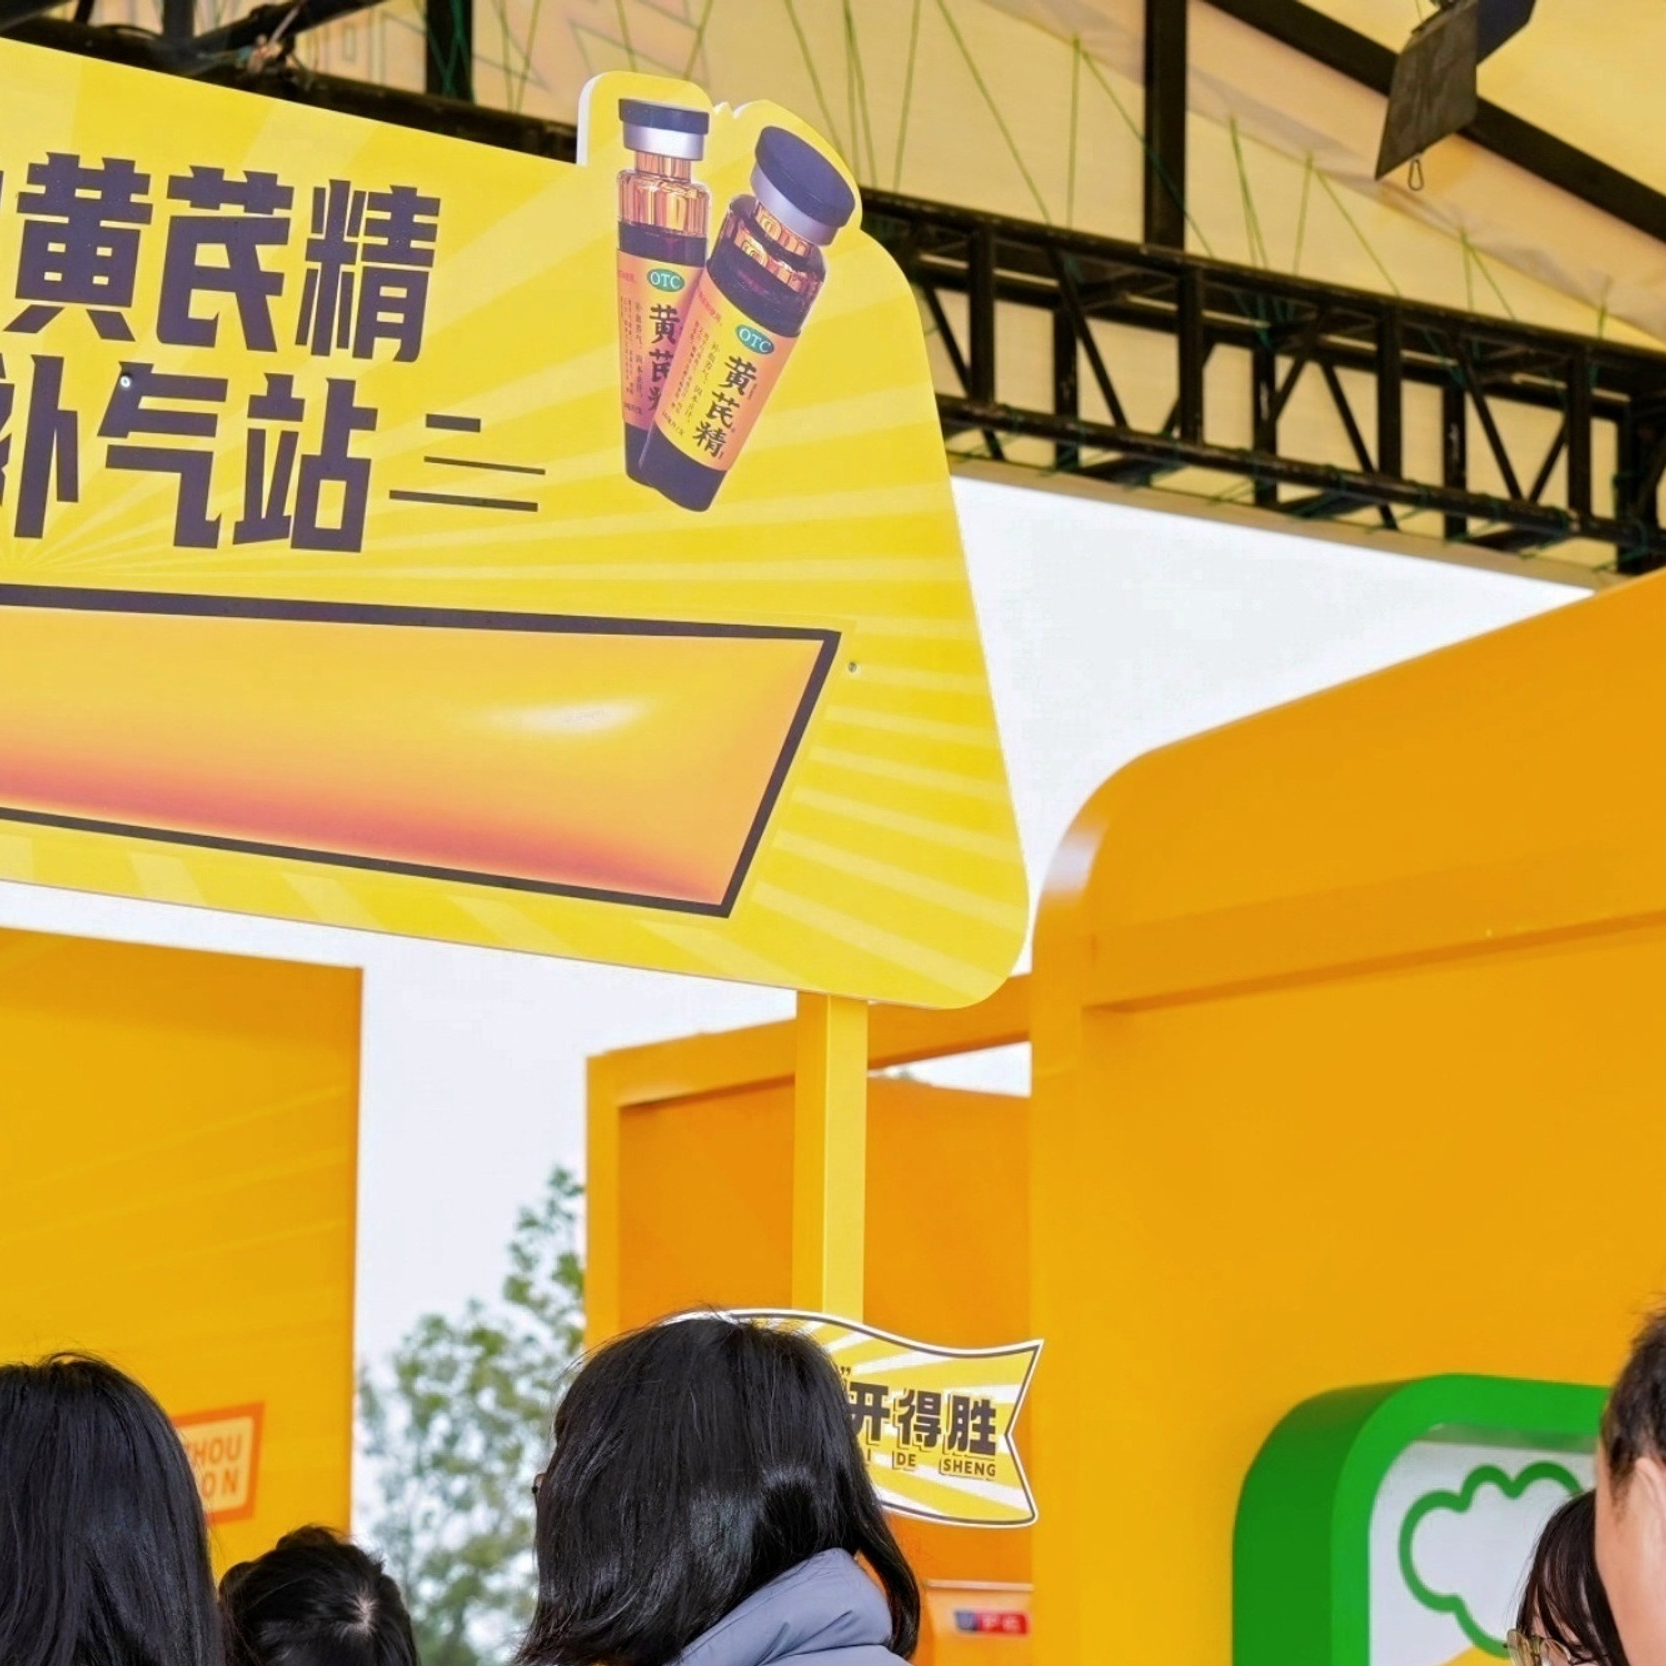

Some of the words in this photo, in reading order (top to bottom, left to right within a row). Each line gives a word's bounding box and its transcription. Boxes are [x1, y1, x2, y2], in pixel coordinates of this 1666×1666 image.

[649, 271, 681, 291] OTC
[738, 328, 771, 353] OTC
[693, 355, 757, 458] 黄芪精
[943, 1458, 996, 1478] SHENG
